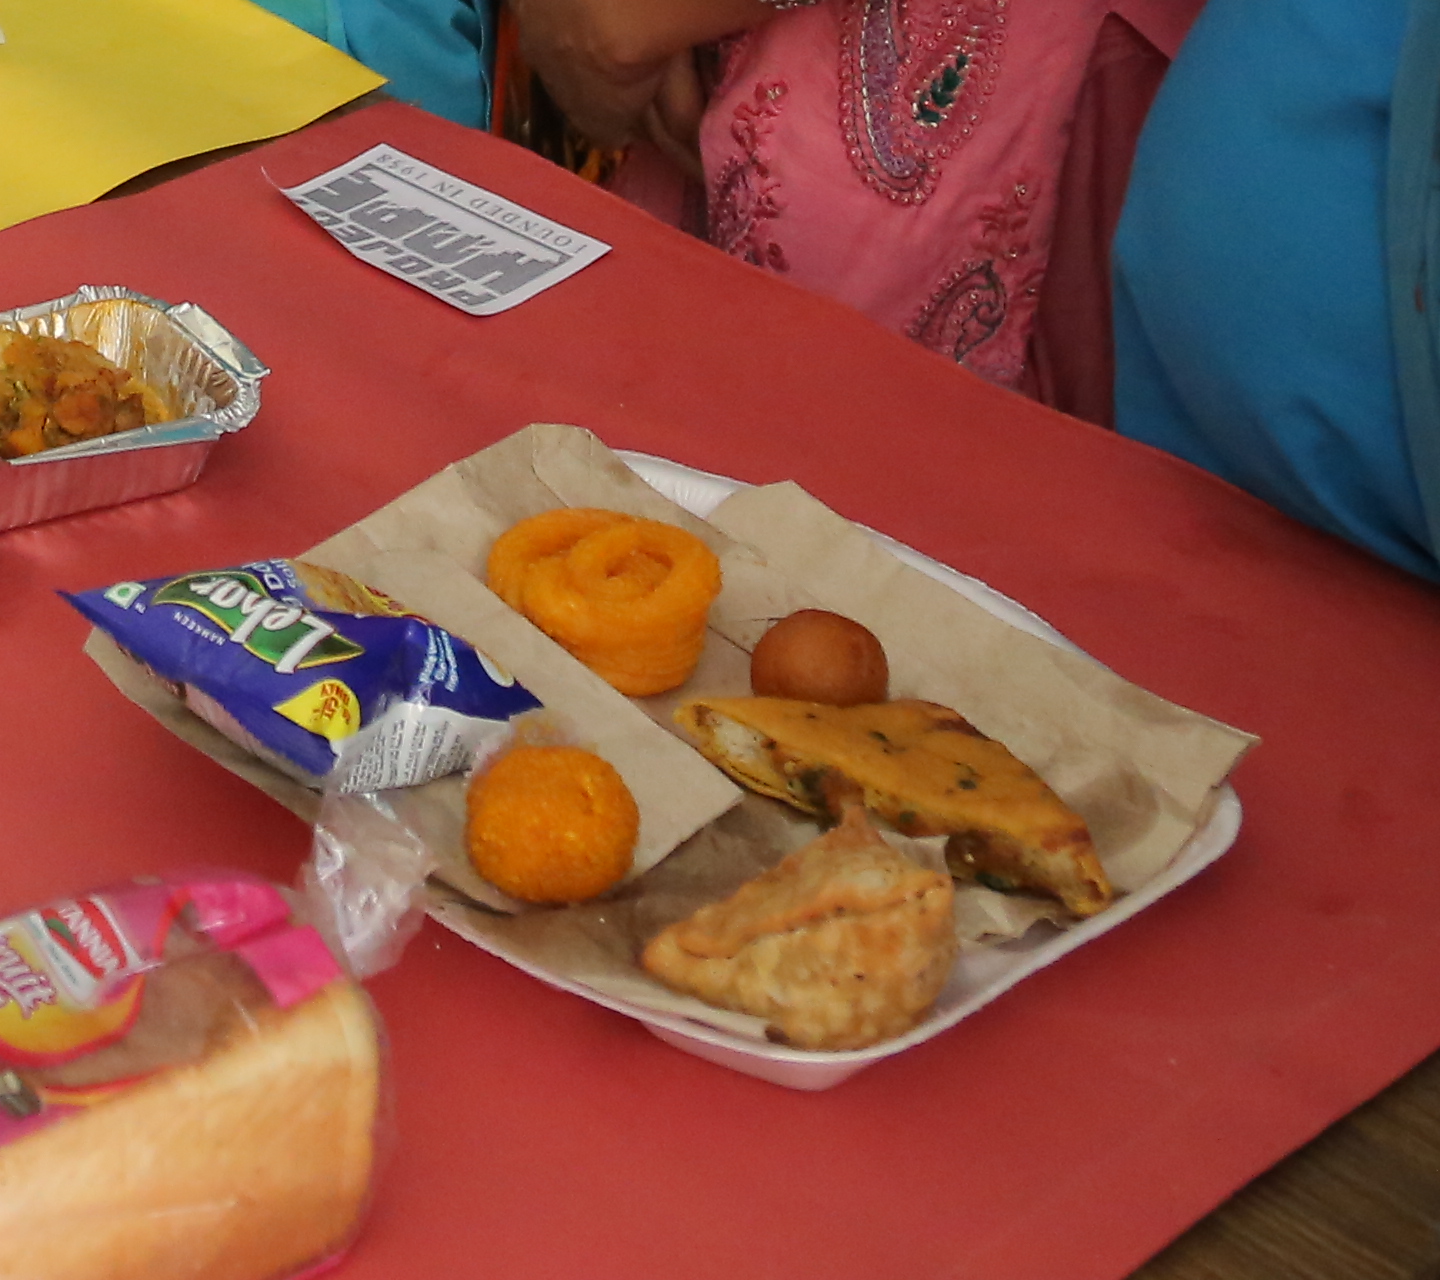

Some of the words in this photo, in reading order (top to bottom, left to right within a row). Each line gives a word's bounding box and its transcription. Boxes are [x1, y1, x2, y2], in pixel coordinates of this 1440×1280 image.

[375, 152, 431, 186] 1958
[435, 178, 466, 203] IN
[293, 197, 498, 306] PROJEC
[174, 610, 226, 646] NAMKEEN
[189, 576, 335, 674] Lehar
[56, 898, 121, 975] TANNIA
